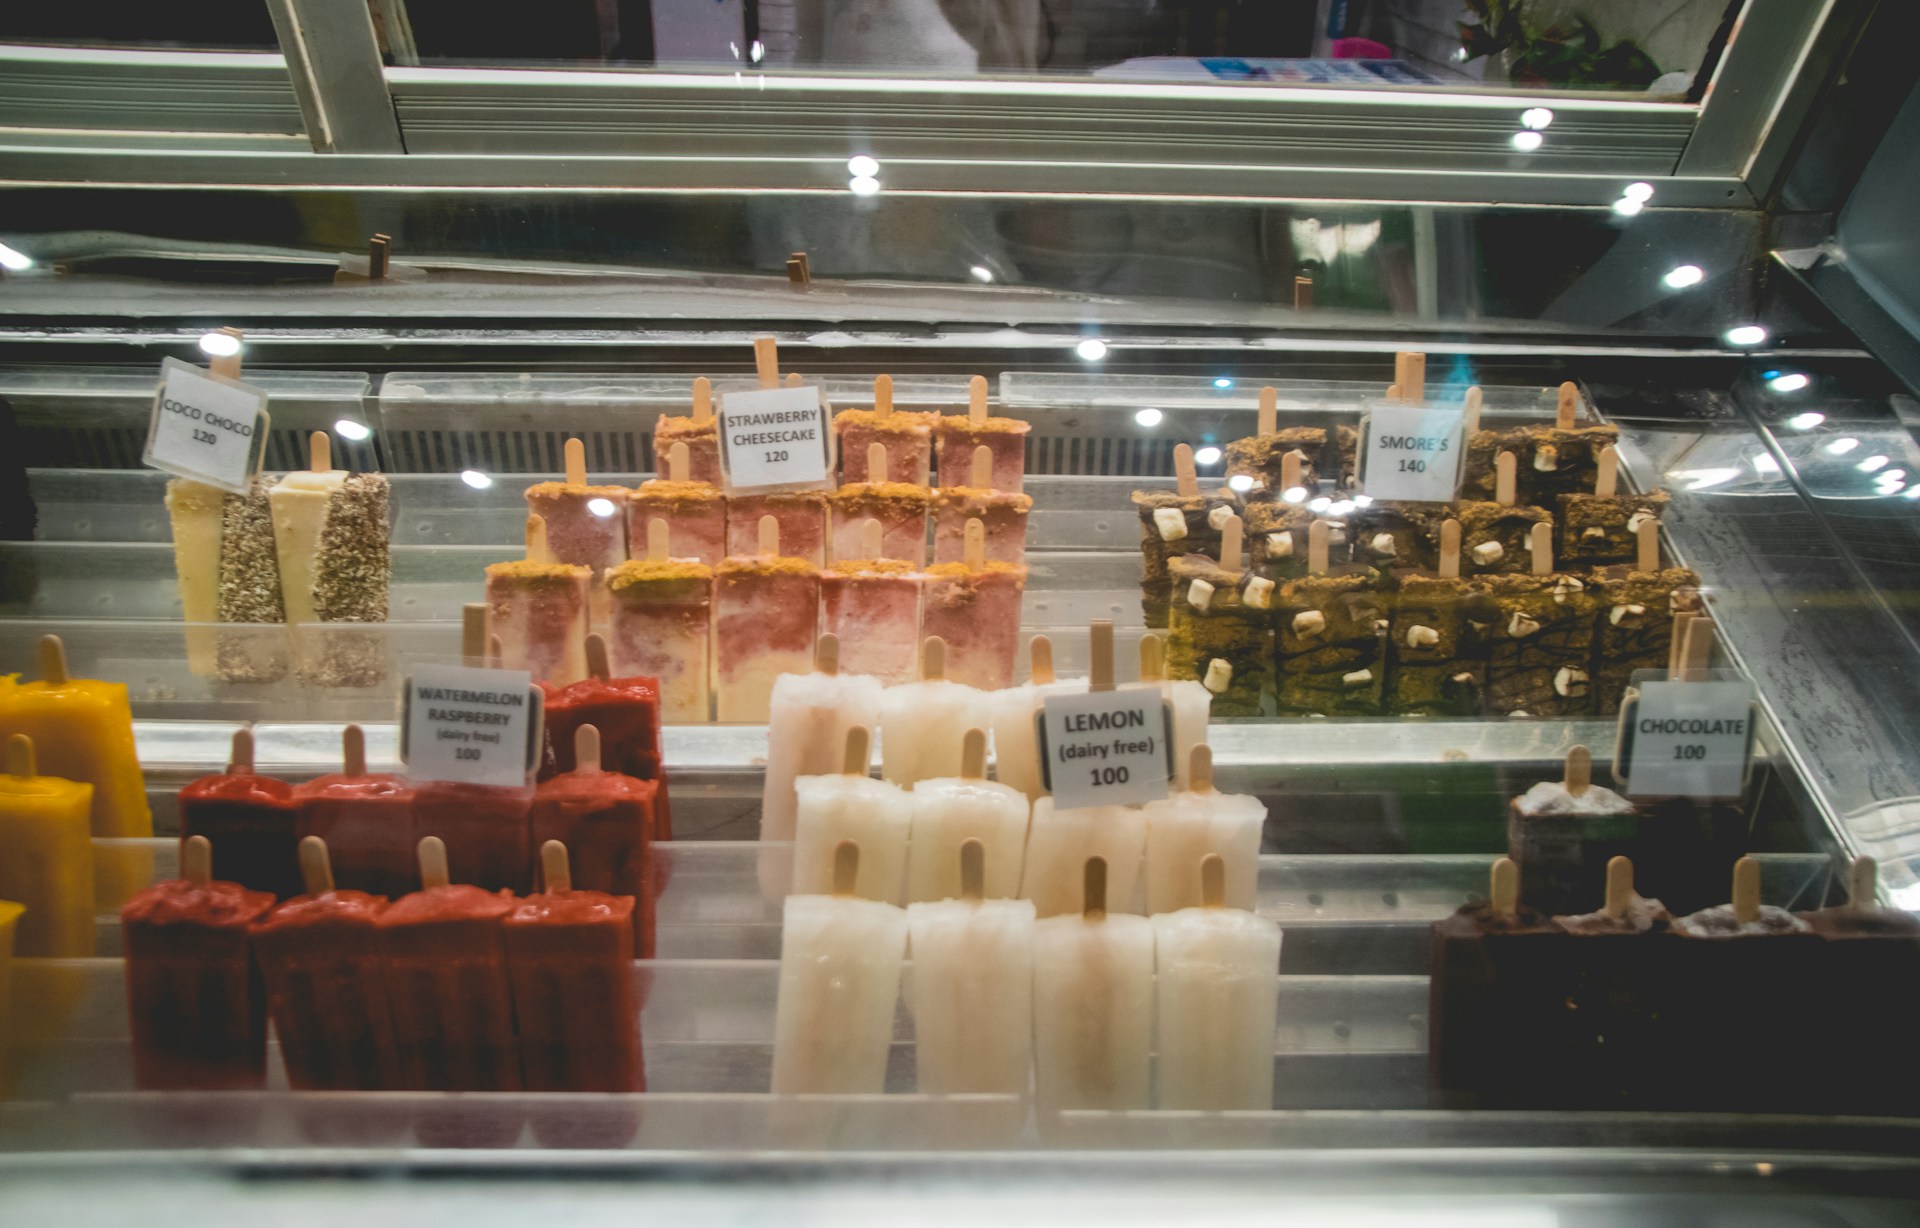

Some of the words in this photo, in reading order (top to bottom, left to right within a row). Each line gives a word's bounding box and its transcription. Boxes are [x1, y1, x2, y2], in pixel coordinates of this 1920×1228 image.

[164, 399, 202, 420] COCO
[204, 413, 252, 437] CHOCO
[727, 410, 817, 428] STRAWBERRY
[191, 428, 217, 445] 120
[733, 429, 816, 446] CHEESECAKE
[764, 450, 789, 463] 120
[1398, 459, 1426, 473] 140
[418, 687, 523, 707] WATERMELON
[427, 708, 512, 726] RASPBERRY
[1064, 709, 1145, 733] LEMON
[1639, 718, 1745, 735] CHOCOLATE
[437, 729, 470, 742] (dairy
[472, 731, 500, 744] free)
[455, 747, 482, 761] 100
[1059, 742, 1110, 762] (dairy
[1113, 736, 1155, 755] free)
[1673, 744, 1706, 760] 100
[1090, 766, 1130, 786] 100
